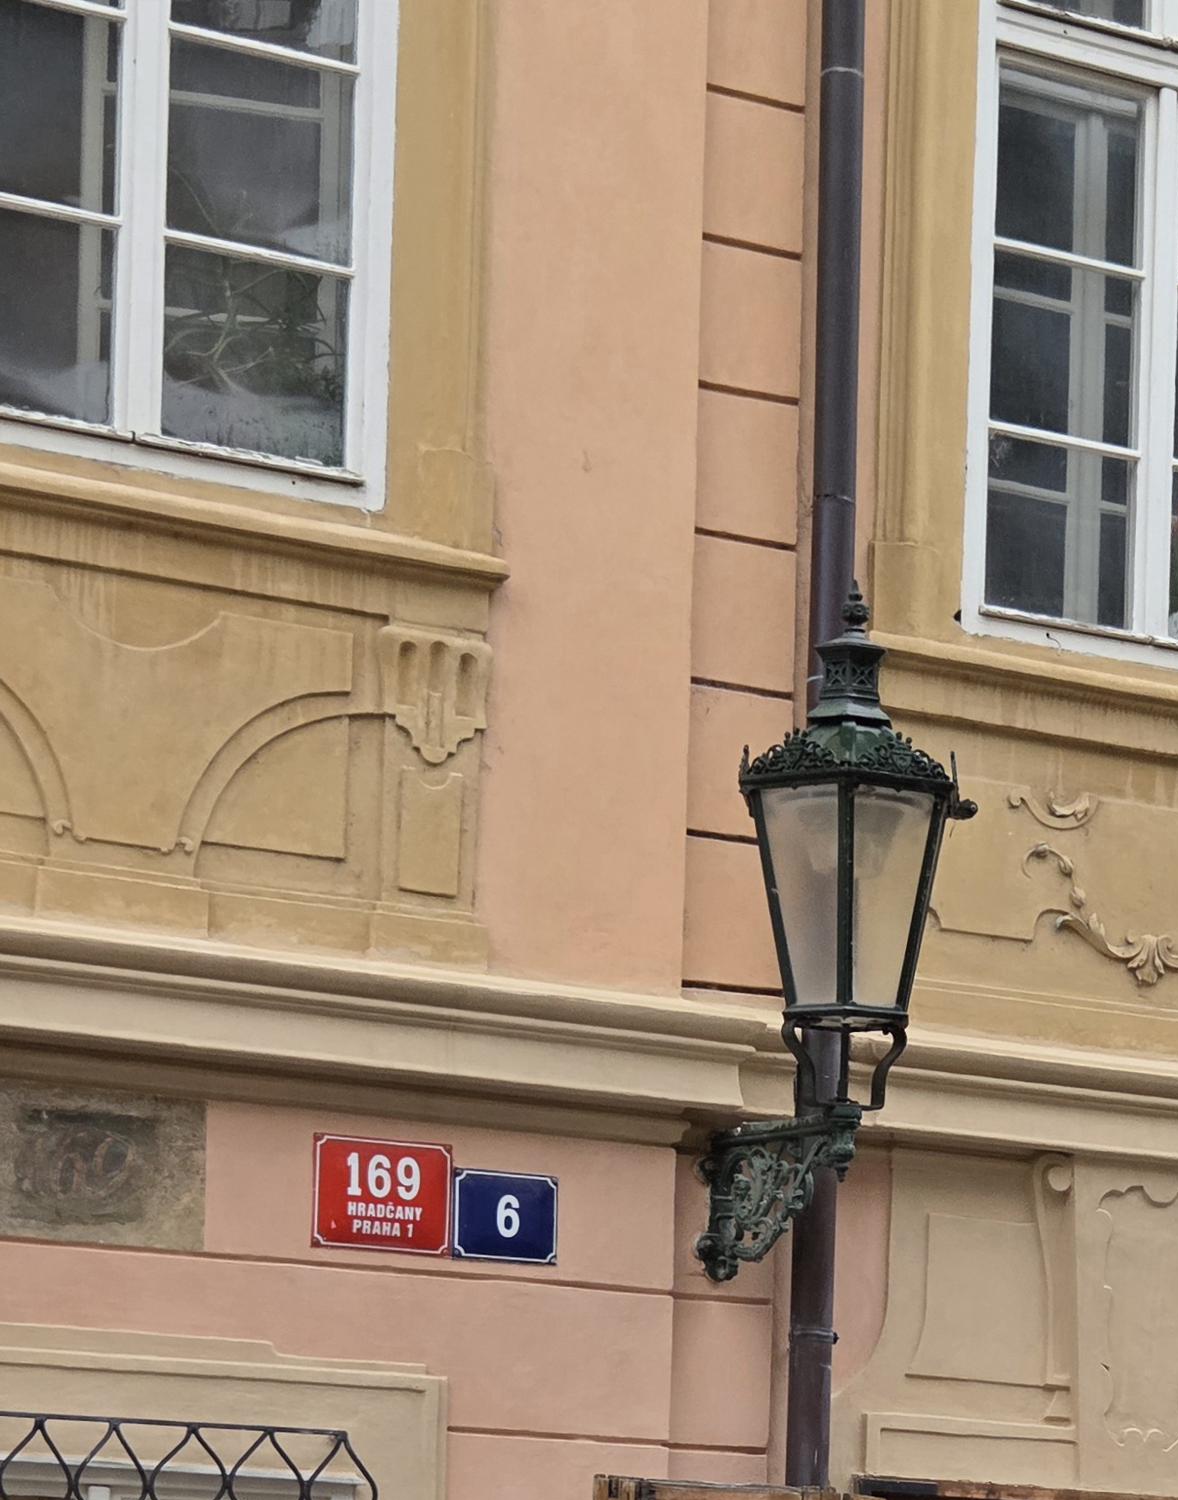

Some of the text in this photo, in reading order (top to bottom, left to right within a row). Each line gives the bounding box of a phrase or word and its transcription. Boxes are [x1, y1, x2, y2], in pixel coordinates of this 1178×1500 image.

[347, 1152, 421, 1201] 169
[347, 1201, 423, 1221] HRADČANY
[496, 1194, 520, 1238] 6
[352, 1220, 413, 1238] PRAHA 1
